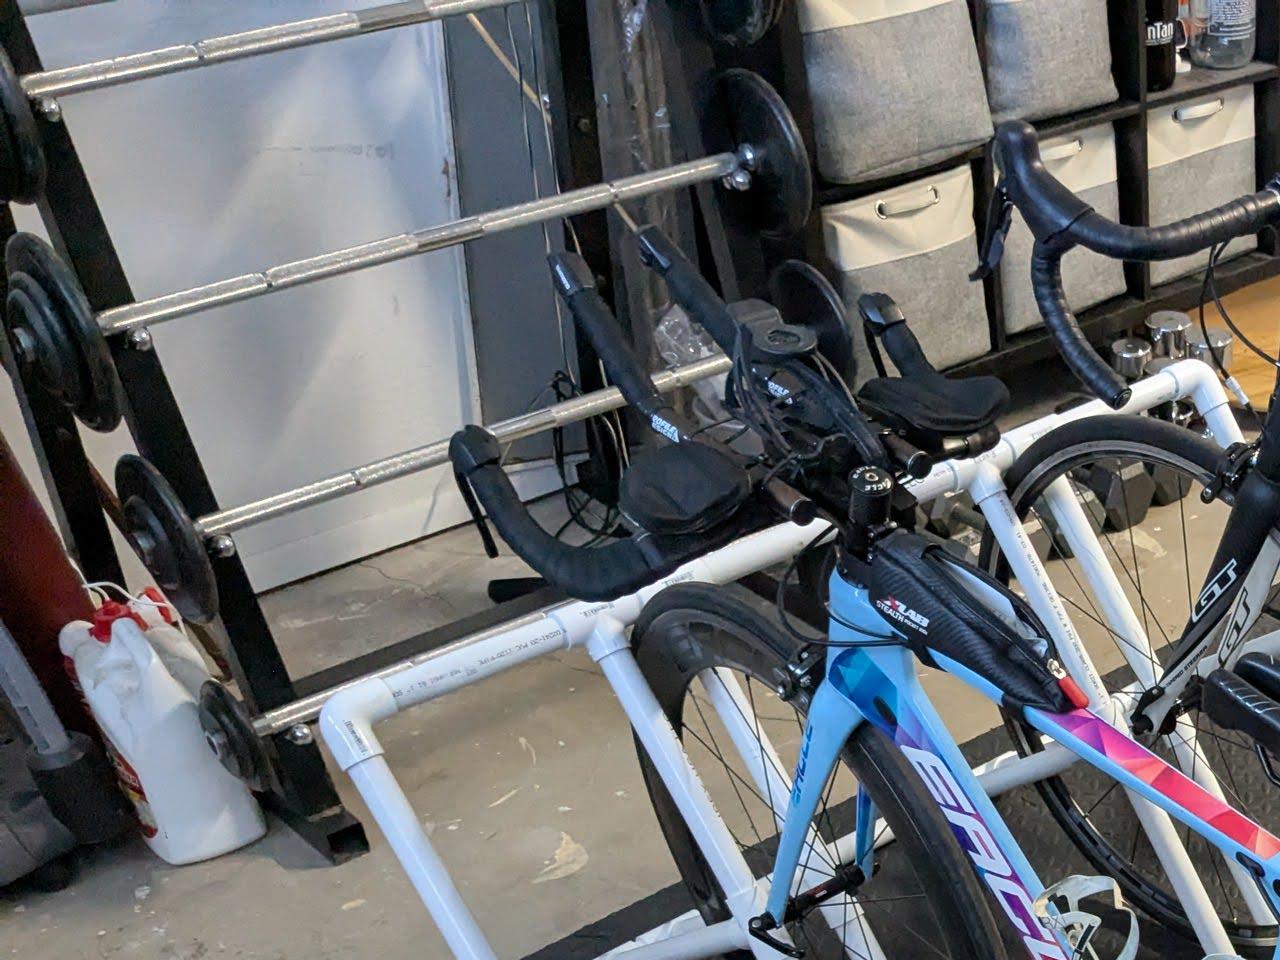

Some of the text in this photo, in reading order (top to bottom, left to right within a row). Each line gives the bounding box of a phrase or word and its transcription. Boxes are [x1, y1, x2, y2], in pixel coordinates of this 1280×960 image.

[876, 600, 905, 623] STEALTH
[1191, 557, 1238, 624] GT
[1219, 584, 1251, 668] GT
